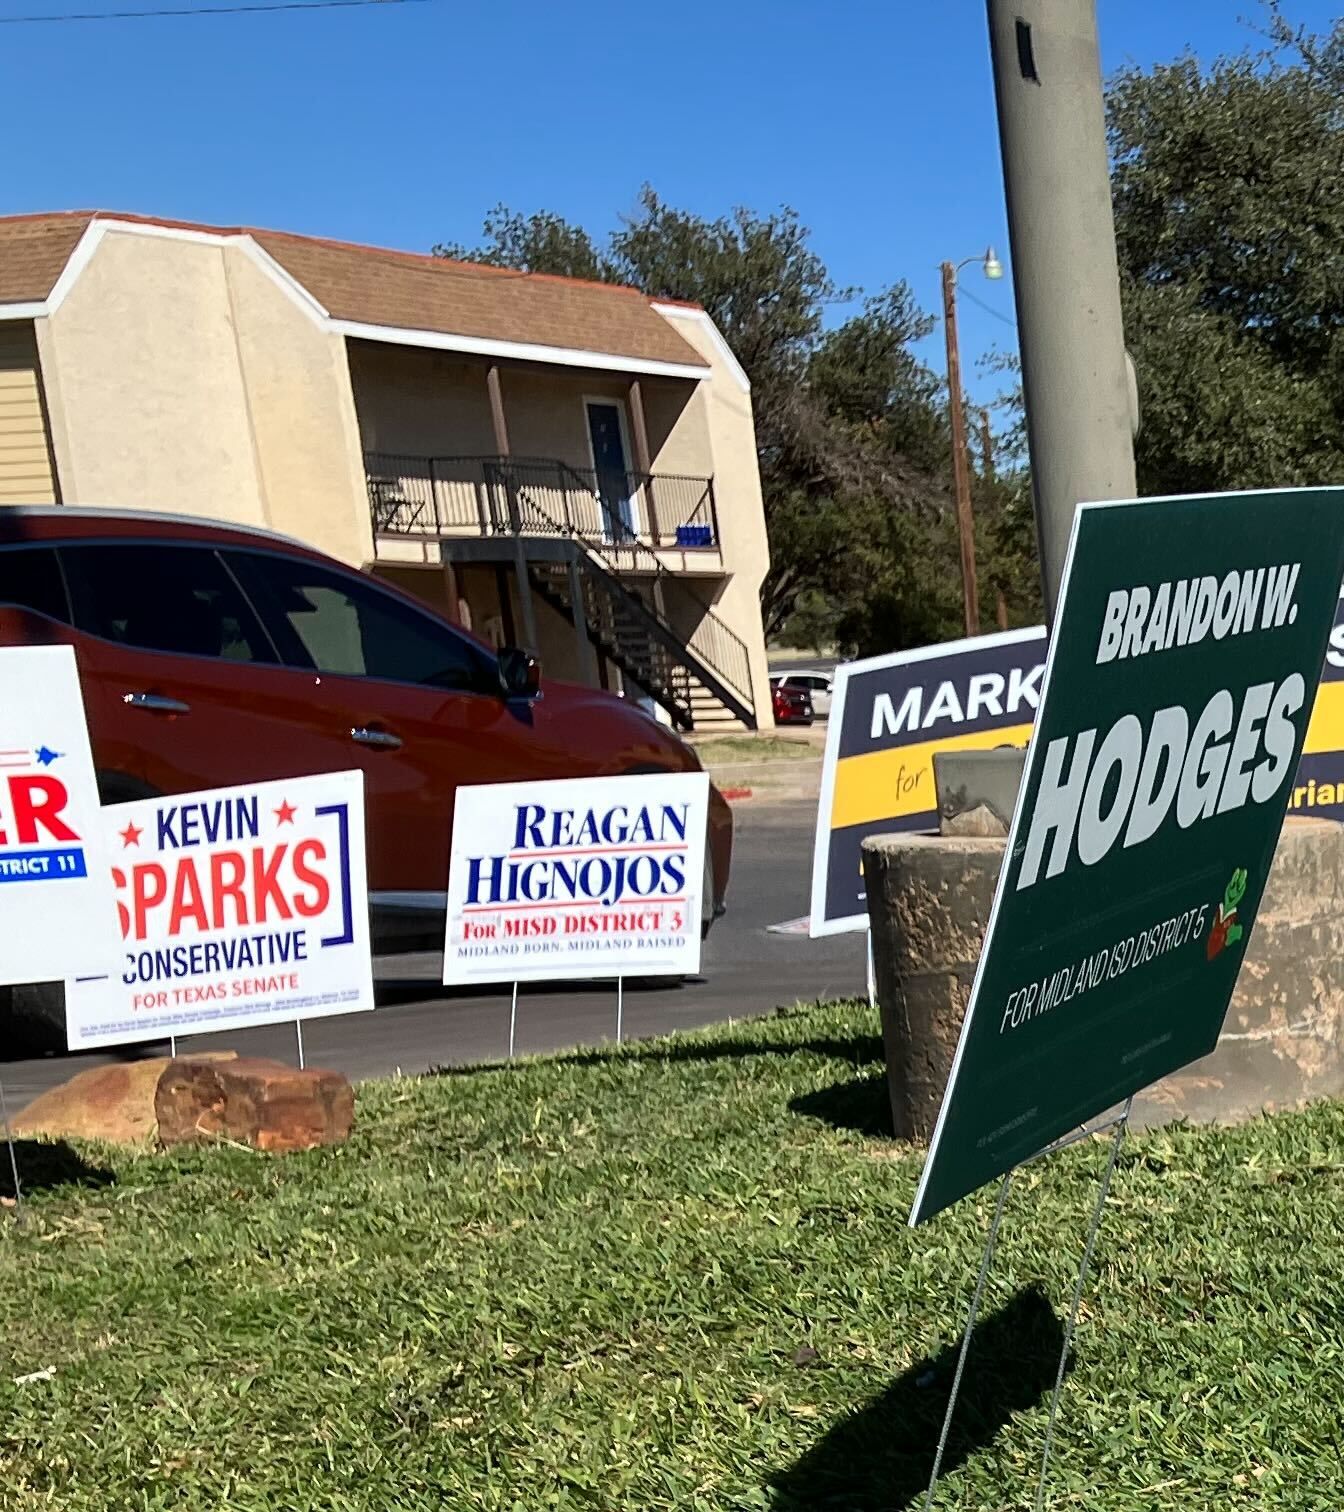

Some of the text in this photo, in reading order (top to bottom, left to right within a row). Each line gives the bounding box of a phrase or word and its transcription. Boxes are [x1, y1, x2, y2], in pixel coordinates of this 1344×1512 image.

[1096, 563, 1301, 664] BRANDON W.
[870, 663, 1047, 739] MARK
[895, 763, 928, 801] for
[1016, 672, 1305, 891] HODGES
[157, 795, 259, 850] KEVIN
[511, 802, 691, 850] REAGAN
[0, 855, 76, 876] TRICT 11
[463, 854, 686, 906] HIGNOJOS
[457, 946, 519, 958] MIDLAND
[567, 939, 633, 951] MIDLAND
[637, 936, 686, 948] RAISED
[503, 917, 557, 938] MISD
[564, 911, 663, 934] DISTRICT
[132, 972, 299, 1011] FOR TEXAS SENATE
[1000, 904, 1209, 1034] FOR MIDLAND ISD DISTRICT 5
